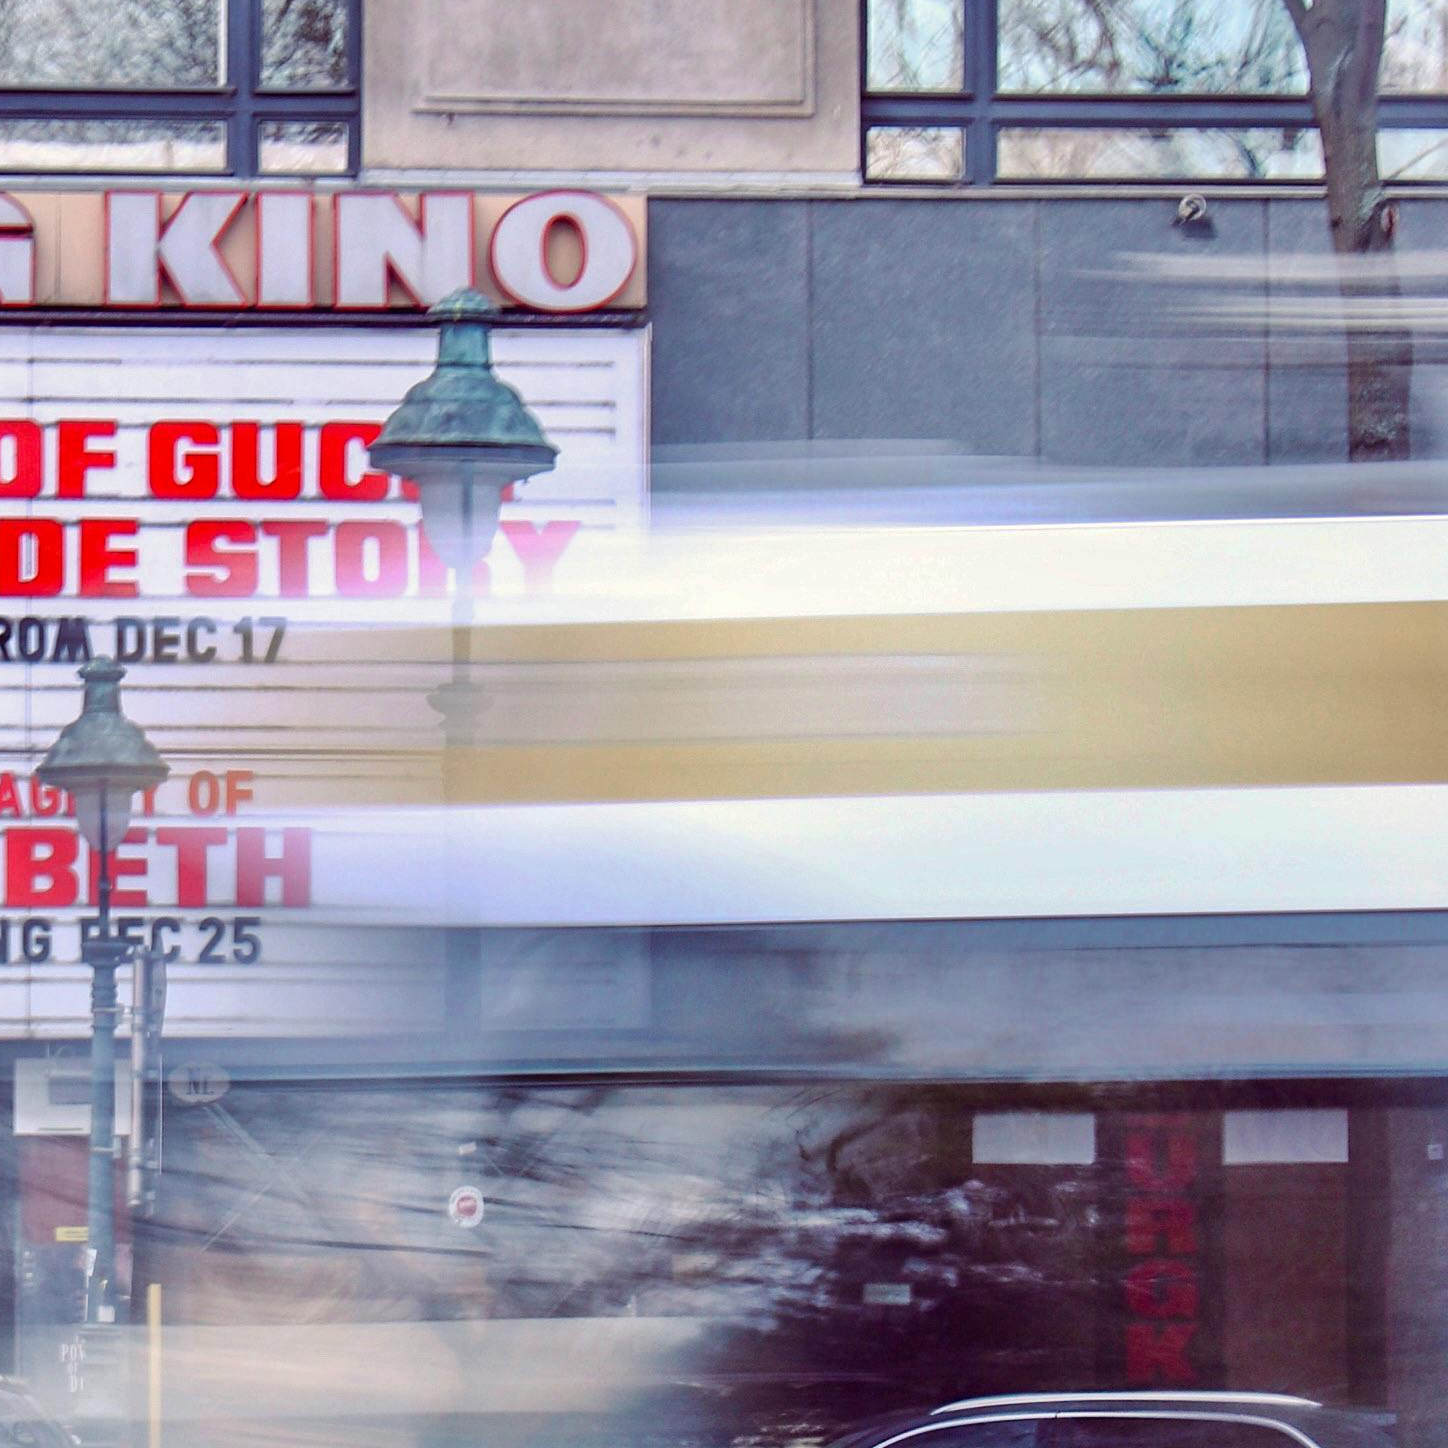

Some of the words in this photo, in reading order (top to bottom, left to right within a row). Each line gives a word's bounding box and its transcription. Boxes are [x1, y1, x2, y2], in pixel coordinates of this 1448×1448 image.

[104, 191, 637, 313] KINO
[114, 618, 220, 663] DEC
[232, 620, 288, 663] 17
[187, 770, 254, 816] OF
[198, 917, 262, 964] 25
